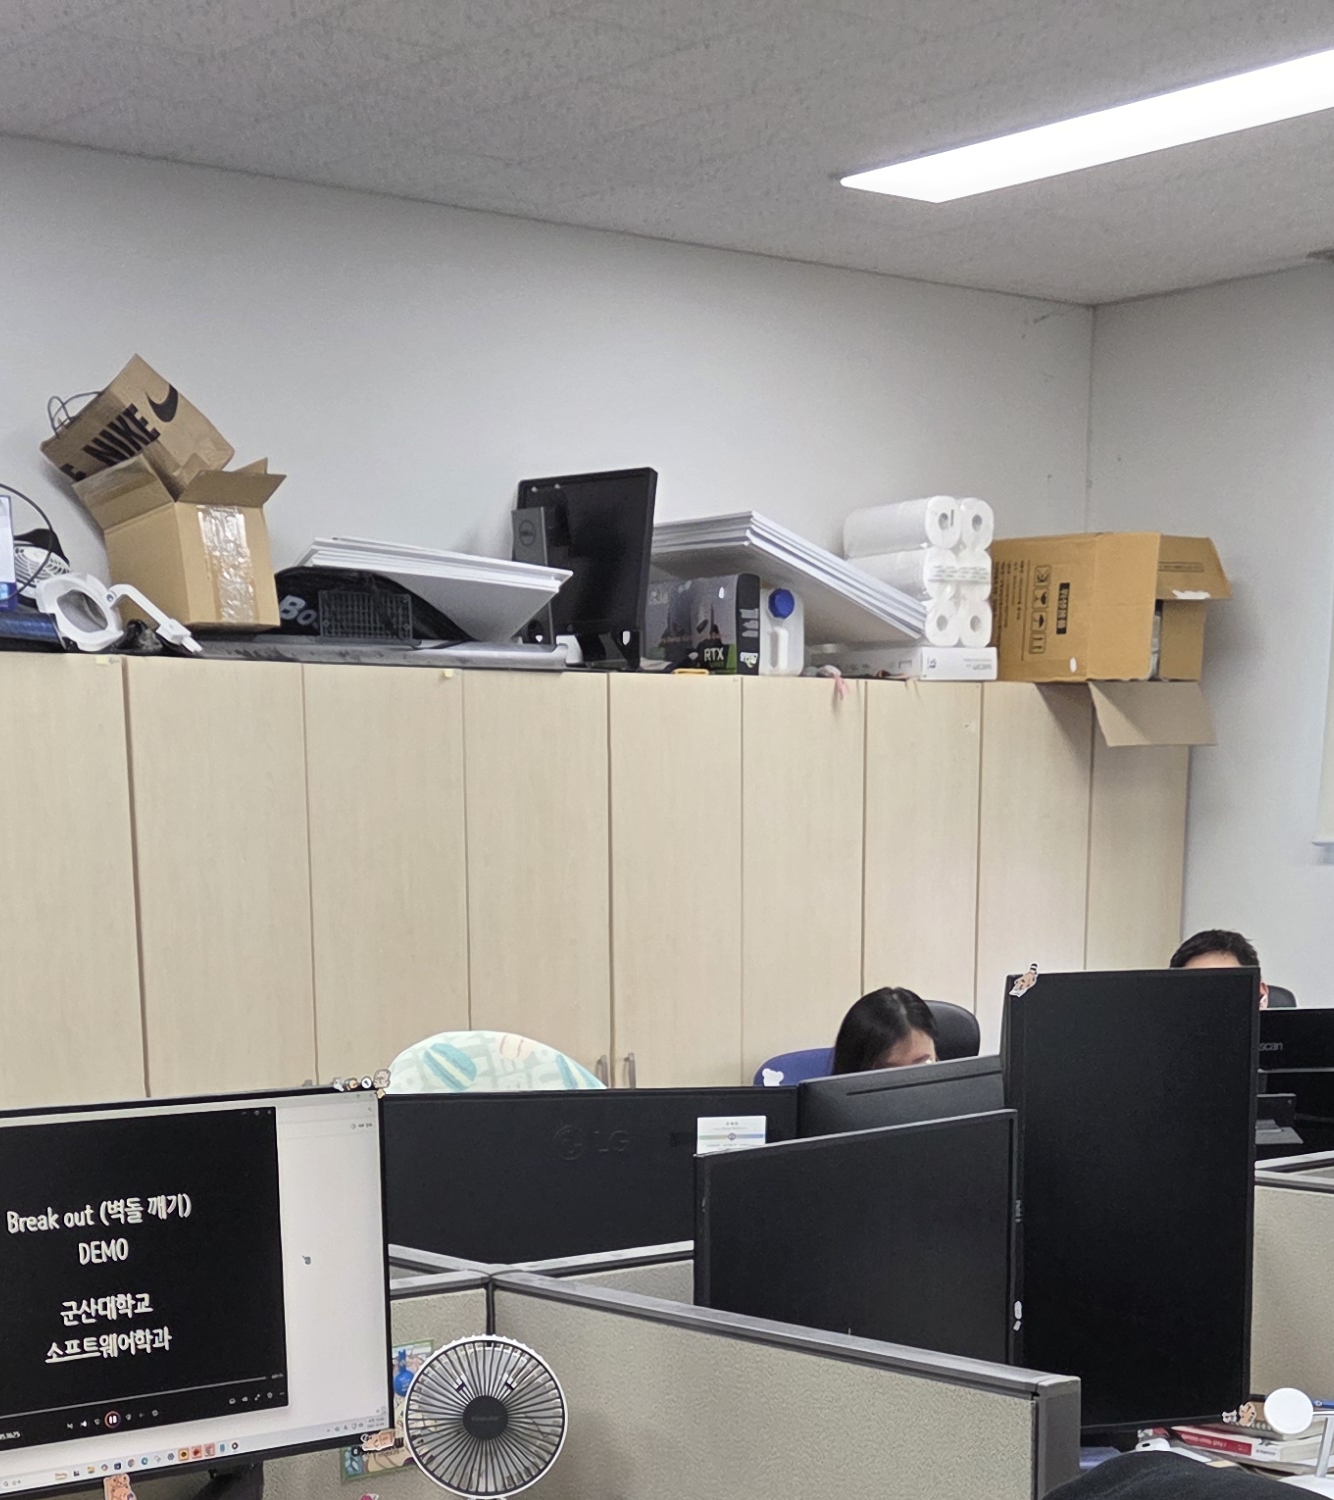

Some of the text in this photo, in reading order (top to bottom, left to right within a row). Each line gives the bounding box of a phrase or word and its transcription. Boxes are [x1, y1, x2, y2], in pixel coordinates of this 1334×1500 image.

[83, 403, 161, 467] NIKE
[279, 594, 318, 627] Bo
[703, 647, 724, 662] RTX
[7, 1193, 192, 1234] Break out (벽돌 깨기)
[78, 1238, 129, 1265] DEMO
[60, 1293, 154, 1327] 군산대학교
[46, 1326, 173, 1361] 소프트웨어학과
